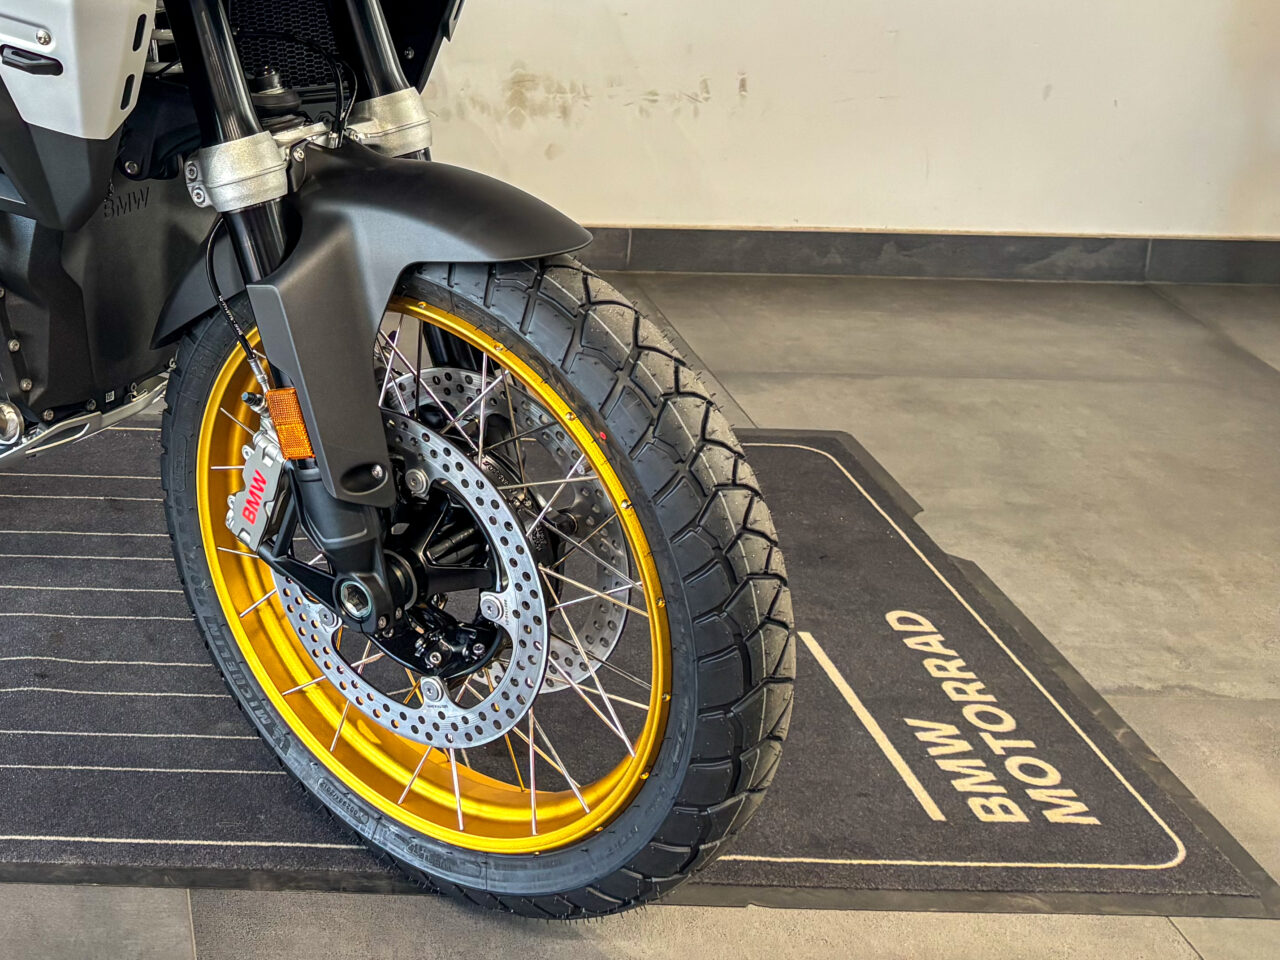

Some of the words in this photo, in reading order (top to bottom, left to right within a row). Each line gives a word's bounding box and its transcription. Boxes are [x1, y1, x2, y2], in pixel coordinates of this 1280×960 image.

[103, 186, 150, 219] BMW
[241, 469, 268, 526] BMW
[208, 620, 272, 727] MICHELIN
[884, 609, 1103, 826] MOTORRAD
[903, 717, 1031, 823] BMW
